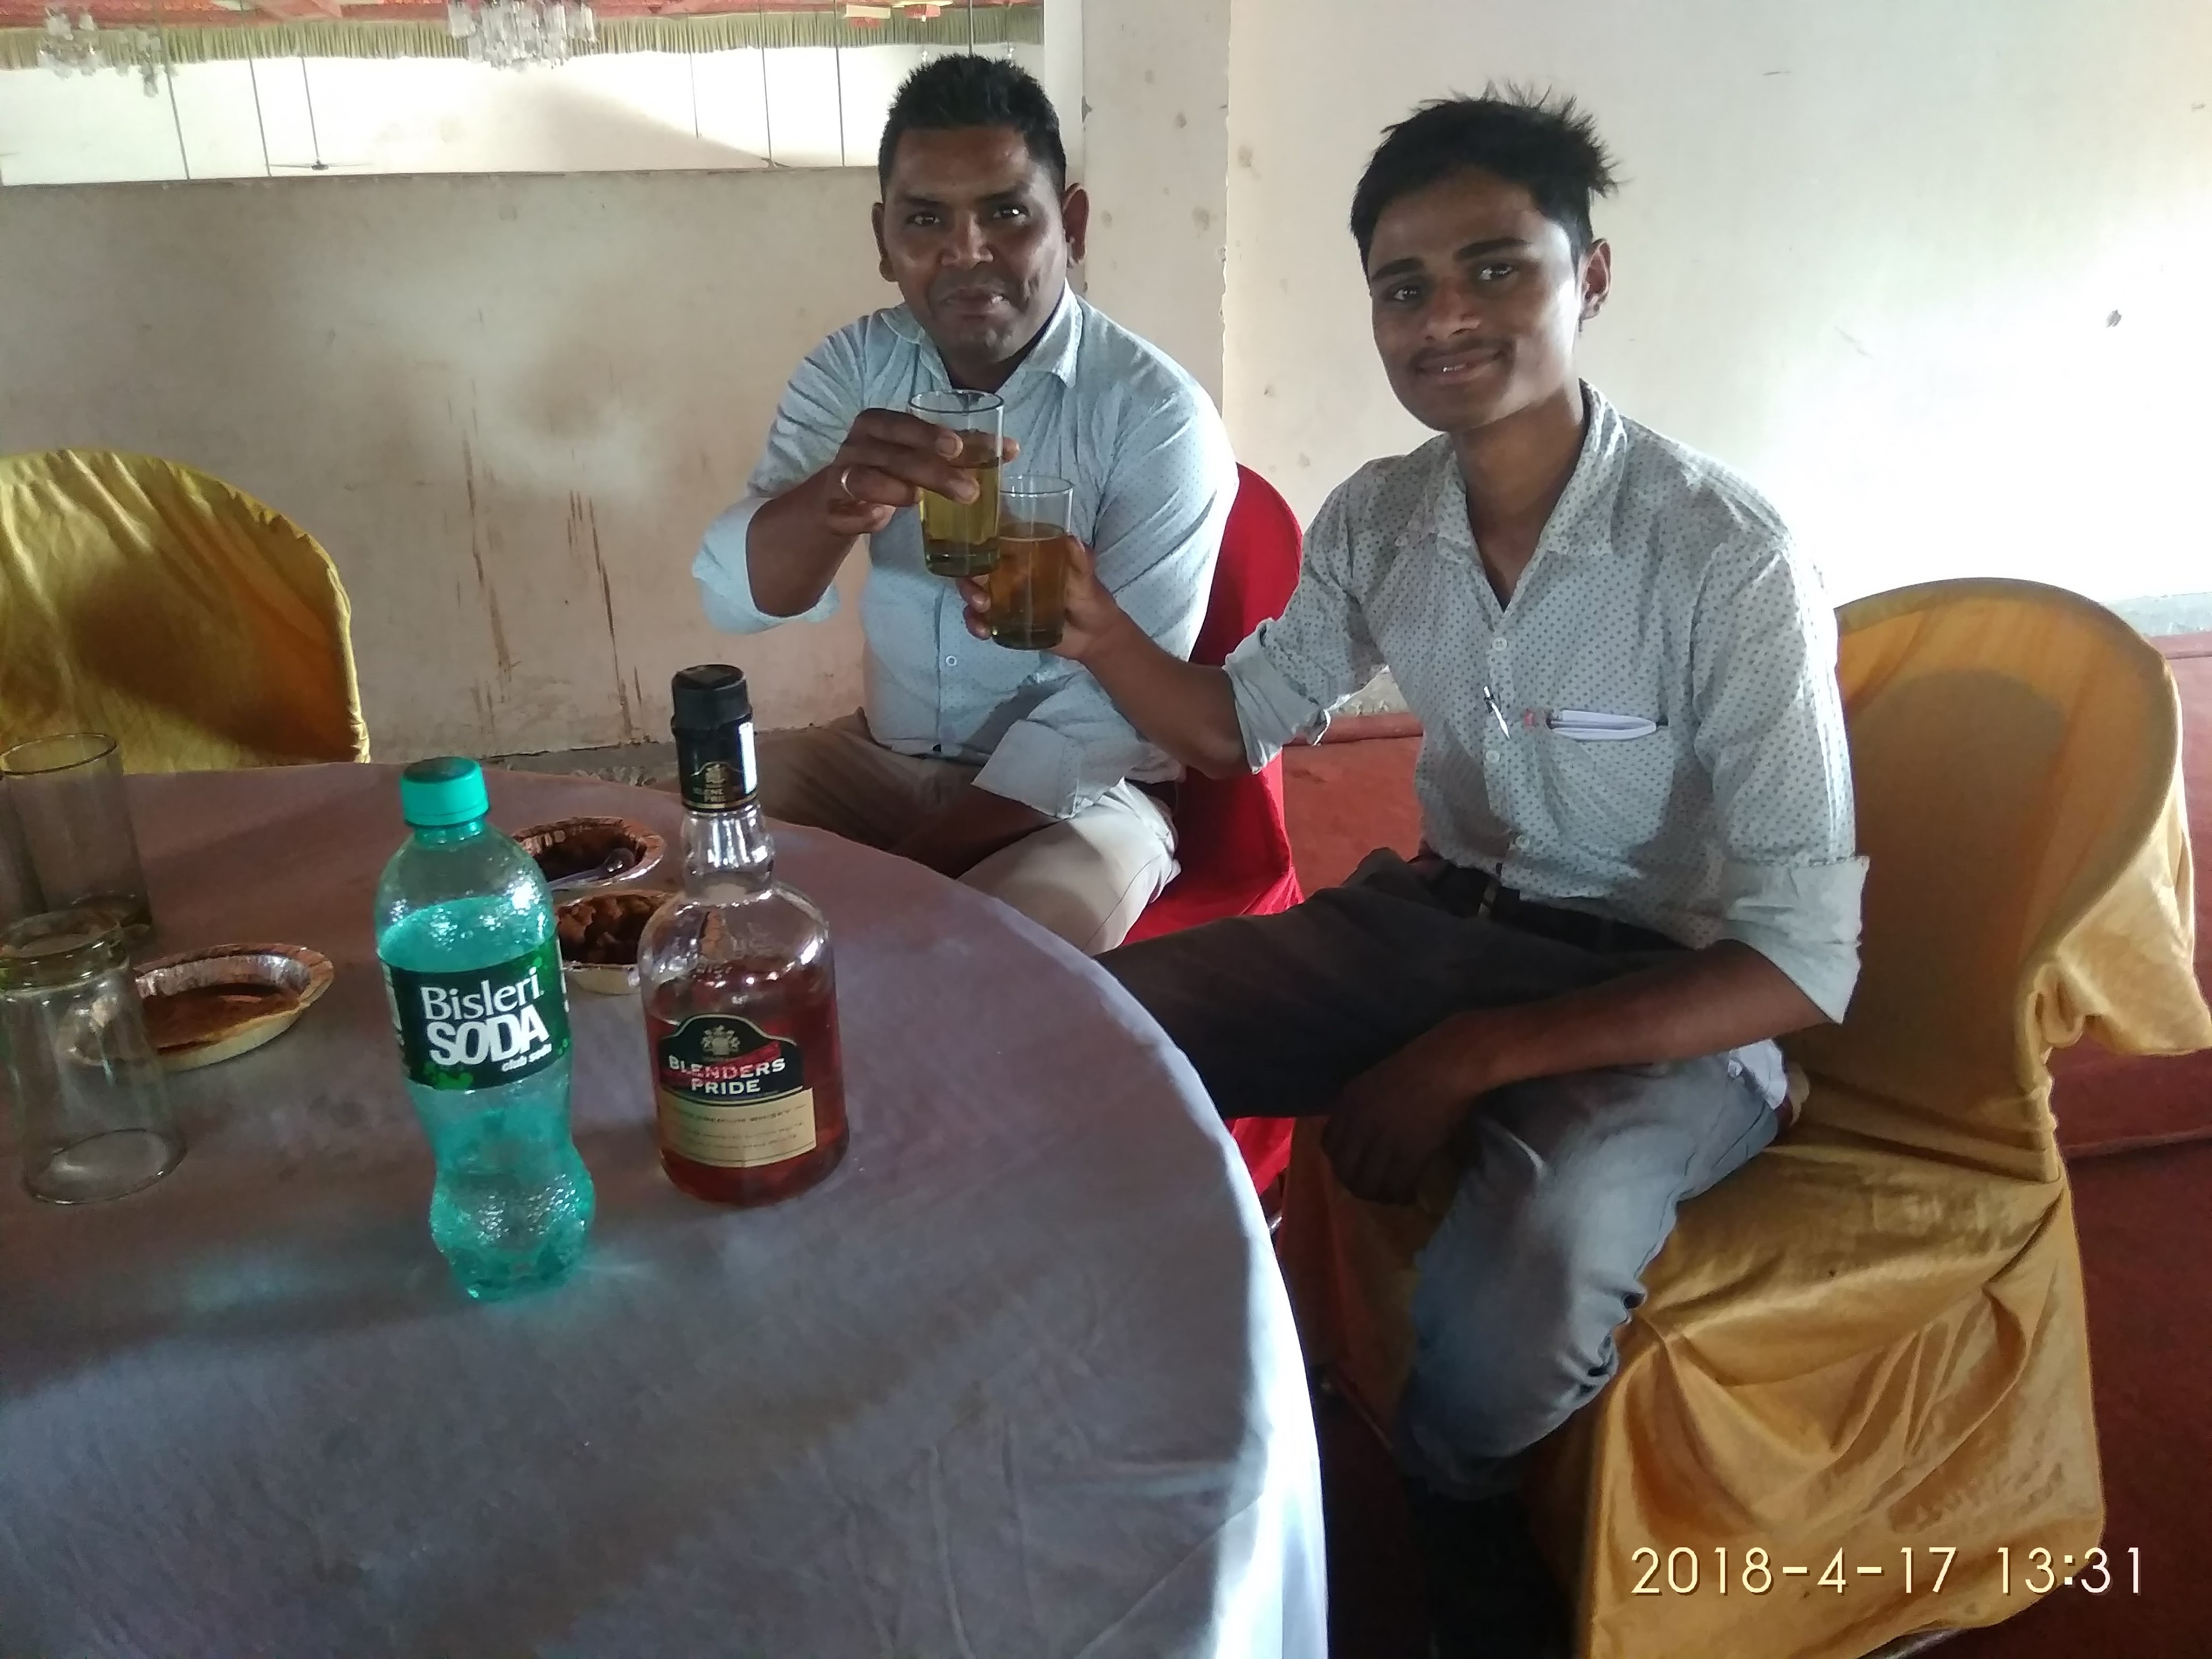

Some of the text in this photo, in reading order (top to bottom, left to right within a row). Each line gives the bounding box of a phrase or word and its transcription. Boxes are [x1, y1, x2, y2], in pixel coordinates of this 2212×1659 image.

[420, 966, 540, 1020] Bisleri
[427, 1004, 550, 1066] SODA
[668, 1054, 786, 1080] BLENDERS
[691, 1077, 761, 1095] PRIDE
